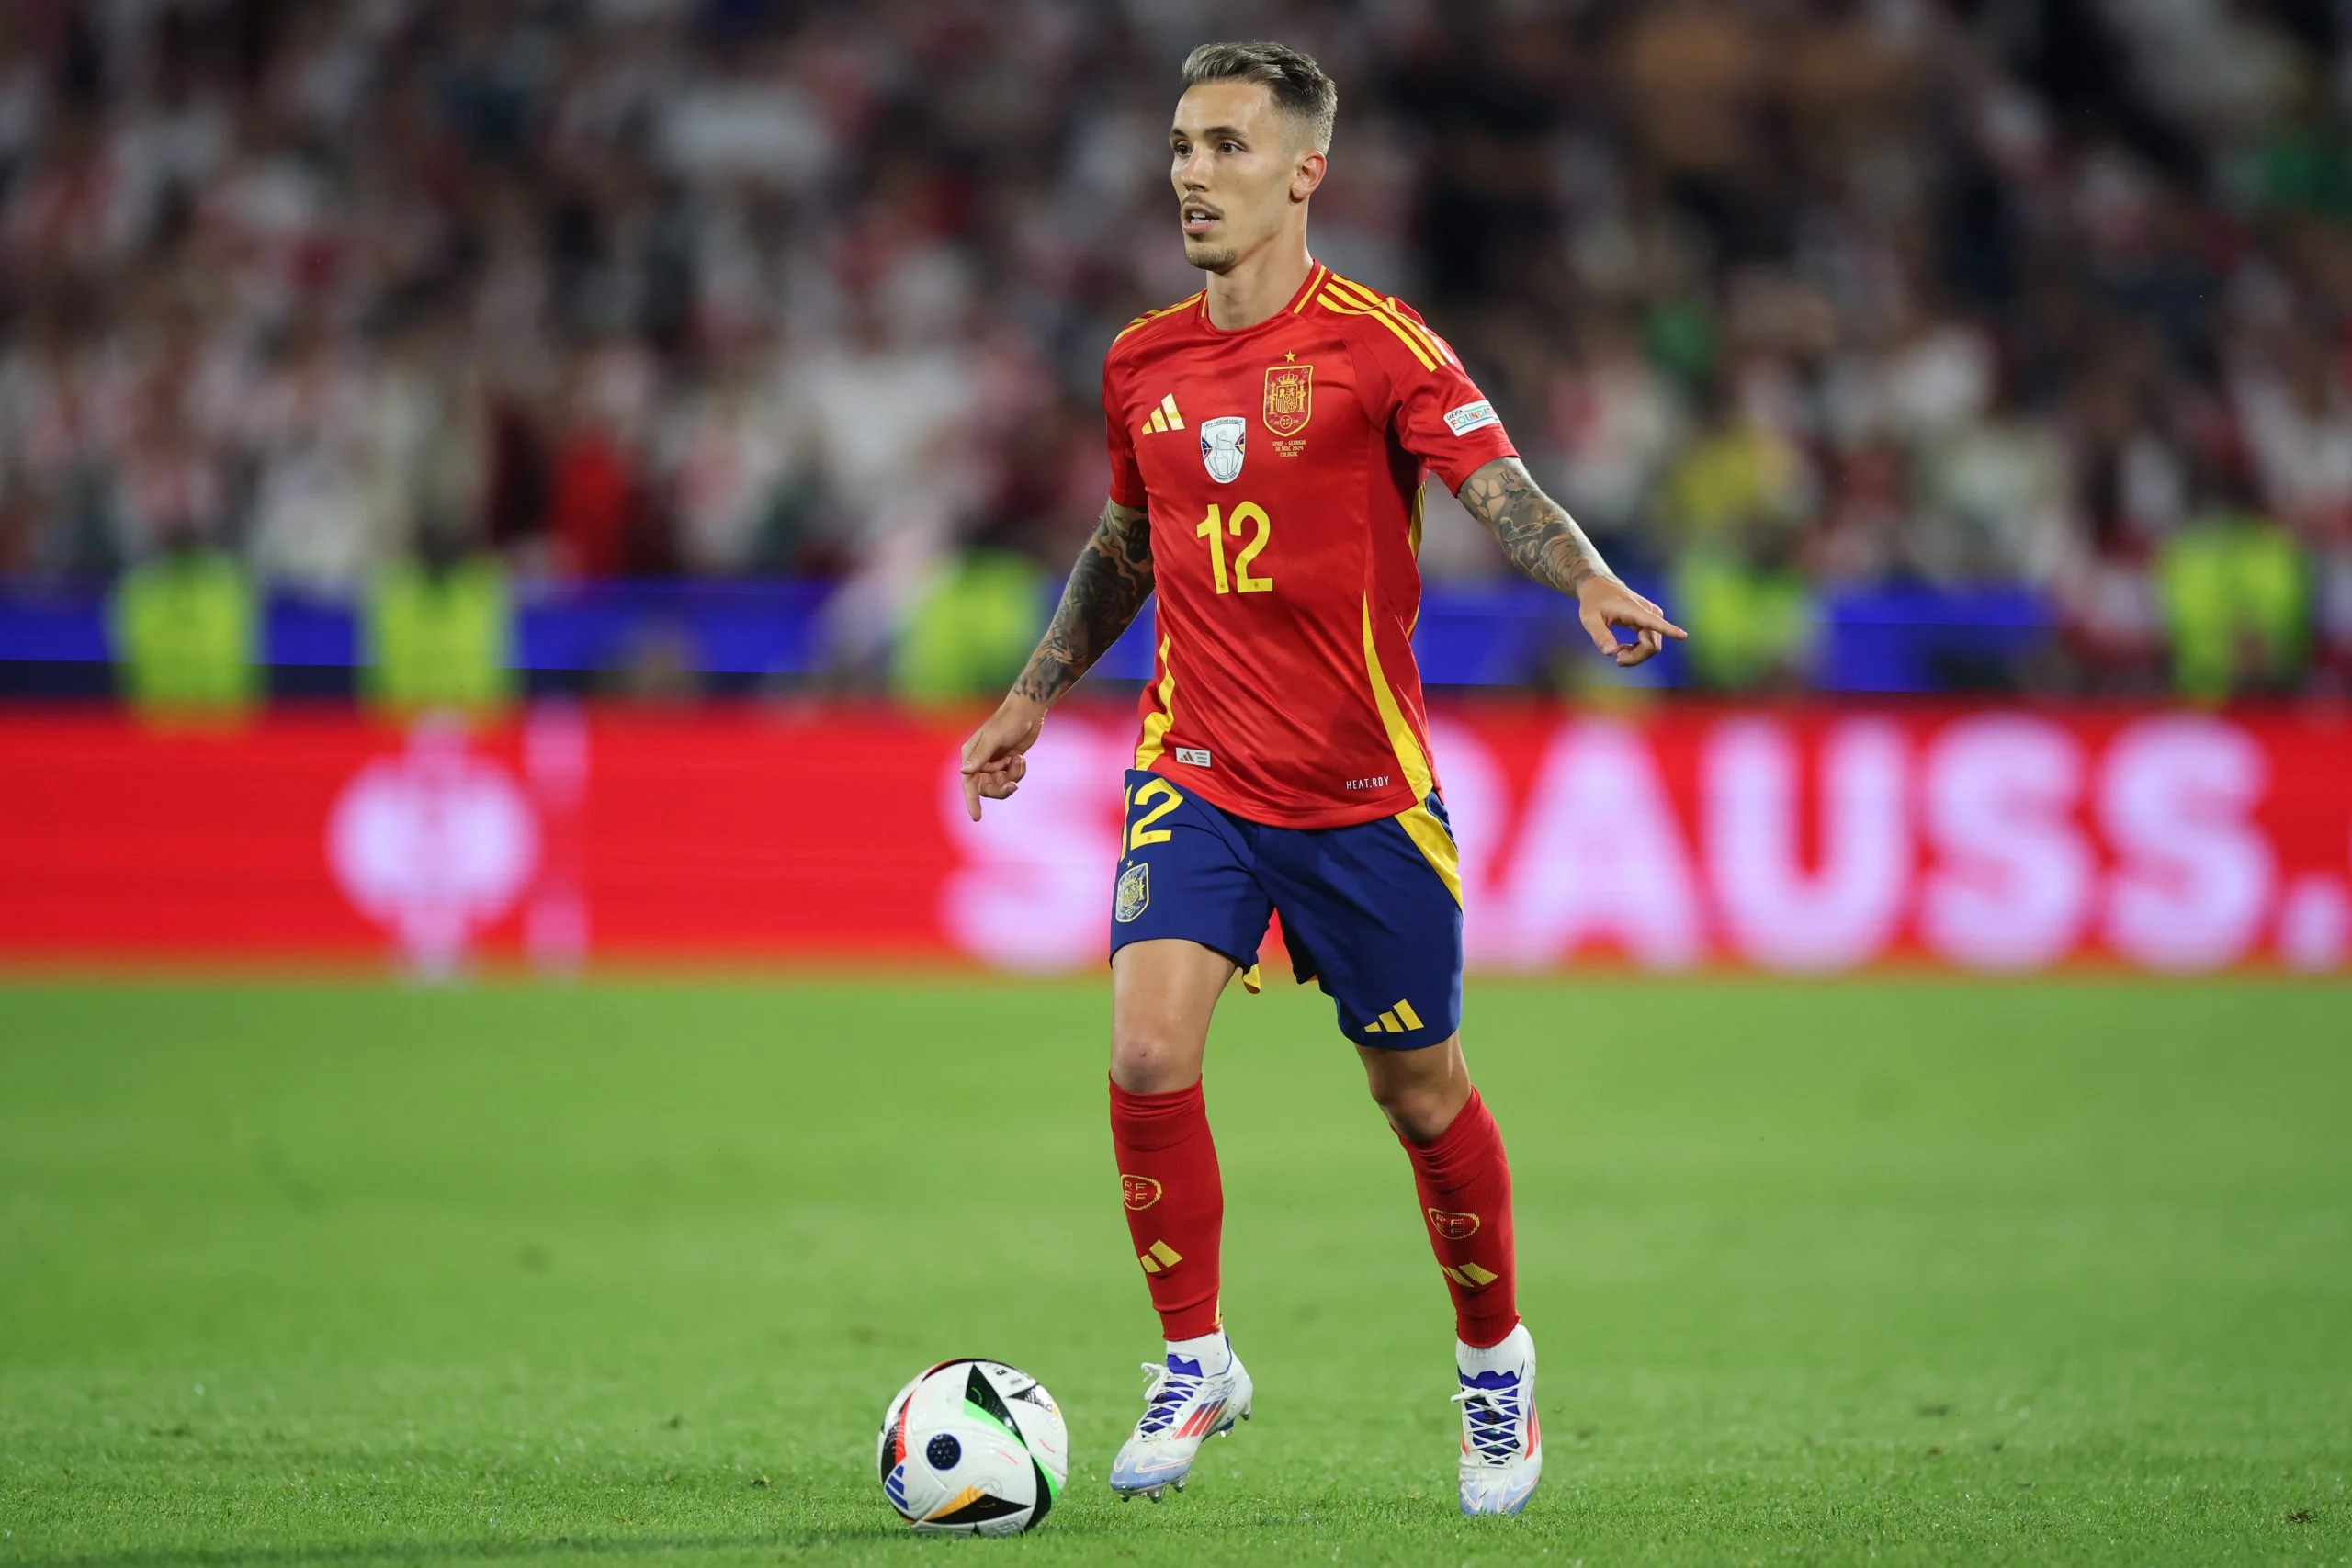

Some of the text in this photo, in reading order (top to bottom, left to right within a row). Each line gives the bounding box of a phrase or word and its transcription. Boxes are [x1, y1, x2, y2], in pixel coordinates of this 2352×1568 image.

[1451, 407, 1496, 428] FOUNDAT
[1196, 501, 1273, 595] 12
[1346, 775, 1389, 790] HEAT.RDY
[939, 712, 2350, 972] SRAUSS.
